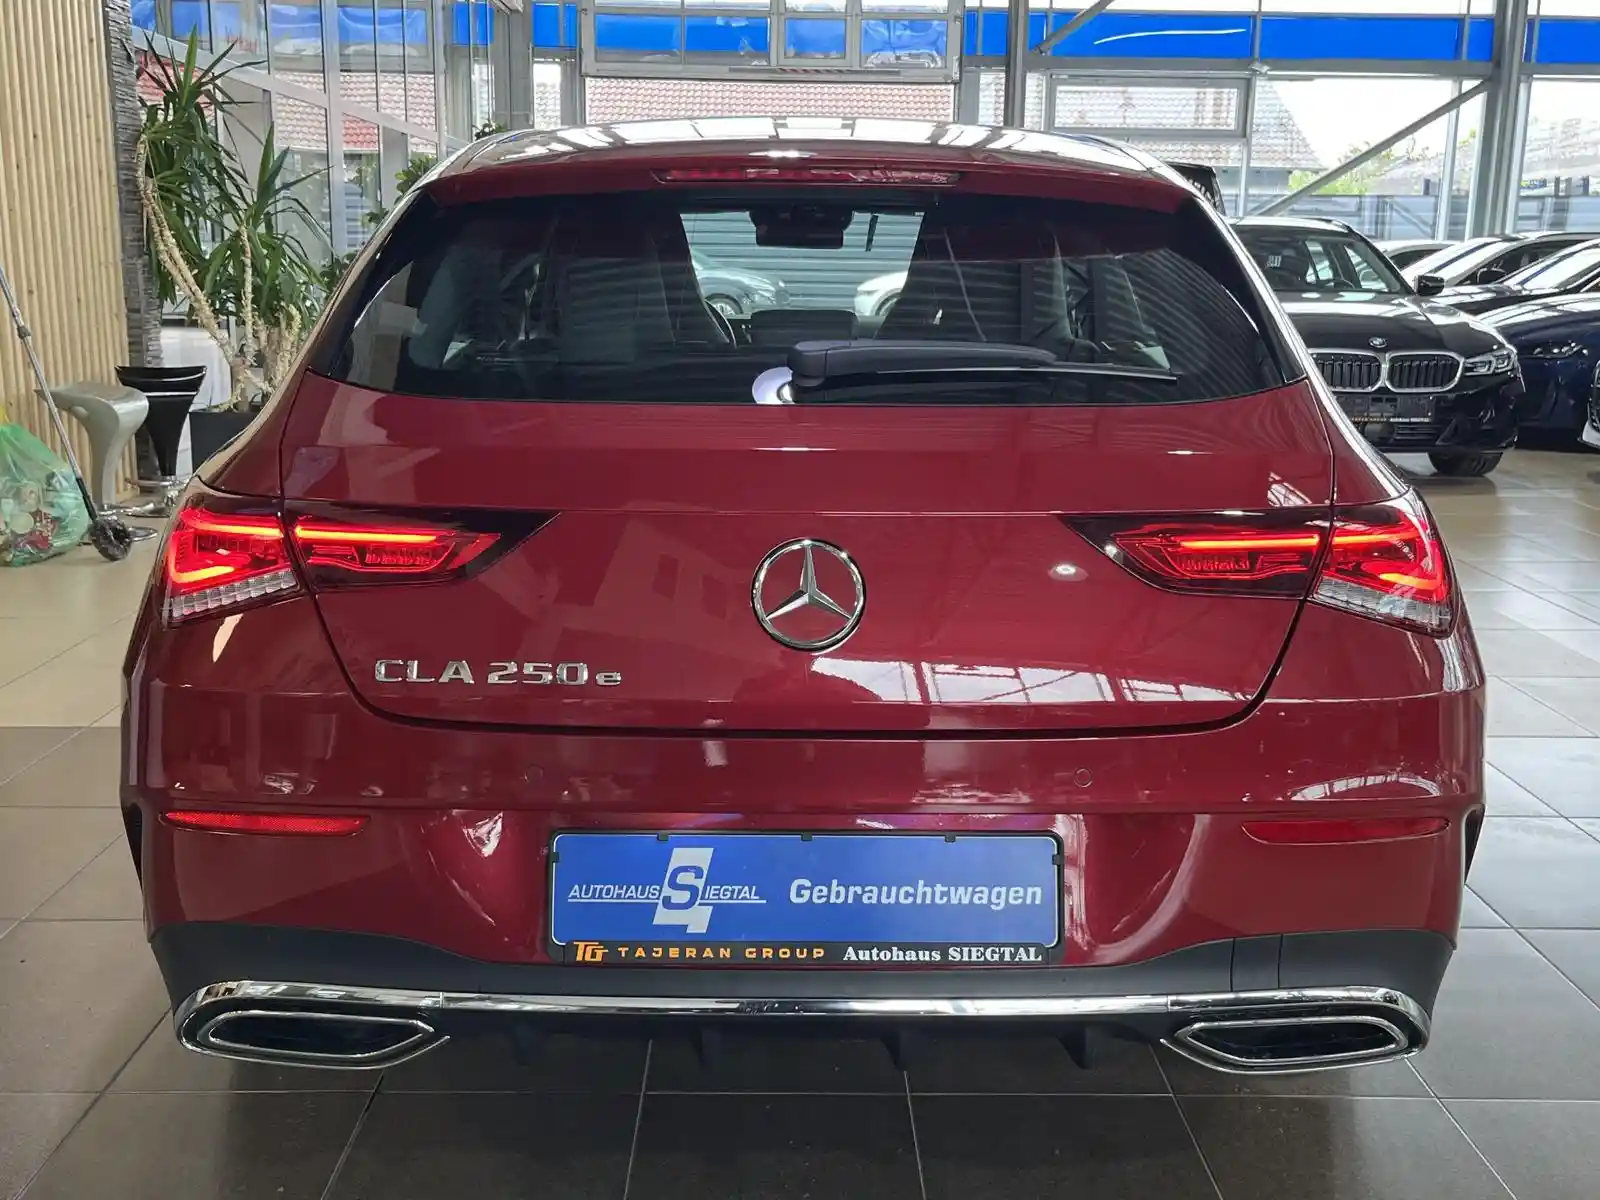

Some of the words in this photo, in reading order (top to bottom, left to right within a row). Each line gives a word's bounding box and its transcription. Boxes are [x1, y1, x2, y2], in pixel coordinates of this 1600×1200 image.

[375, 660, 475, 683] CLA
[567, 884, 661, 900] AUTOHAUS
[661, 865, 760, 911] SIEGTAL
[789, 878, 1042, 911] Gebrauchtwagen
[618, 946, 732, 959] TAJERAN
[745, 947, 825, 959] GROUP
[843, 946, 941, 962] Autohaus
[948, 946, 1042, 962] SIEGTAL
